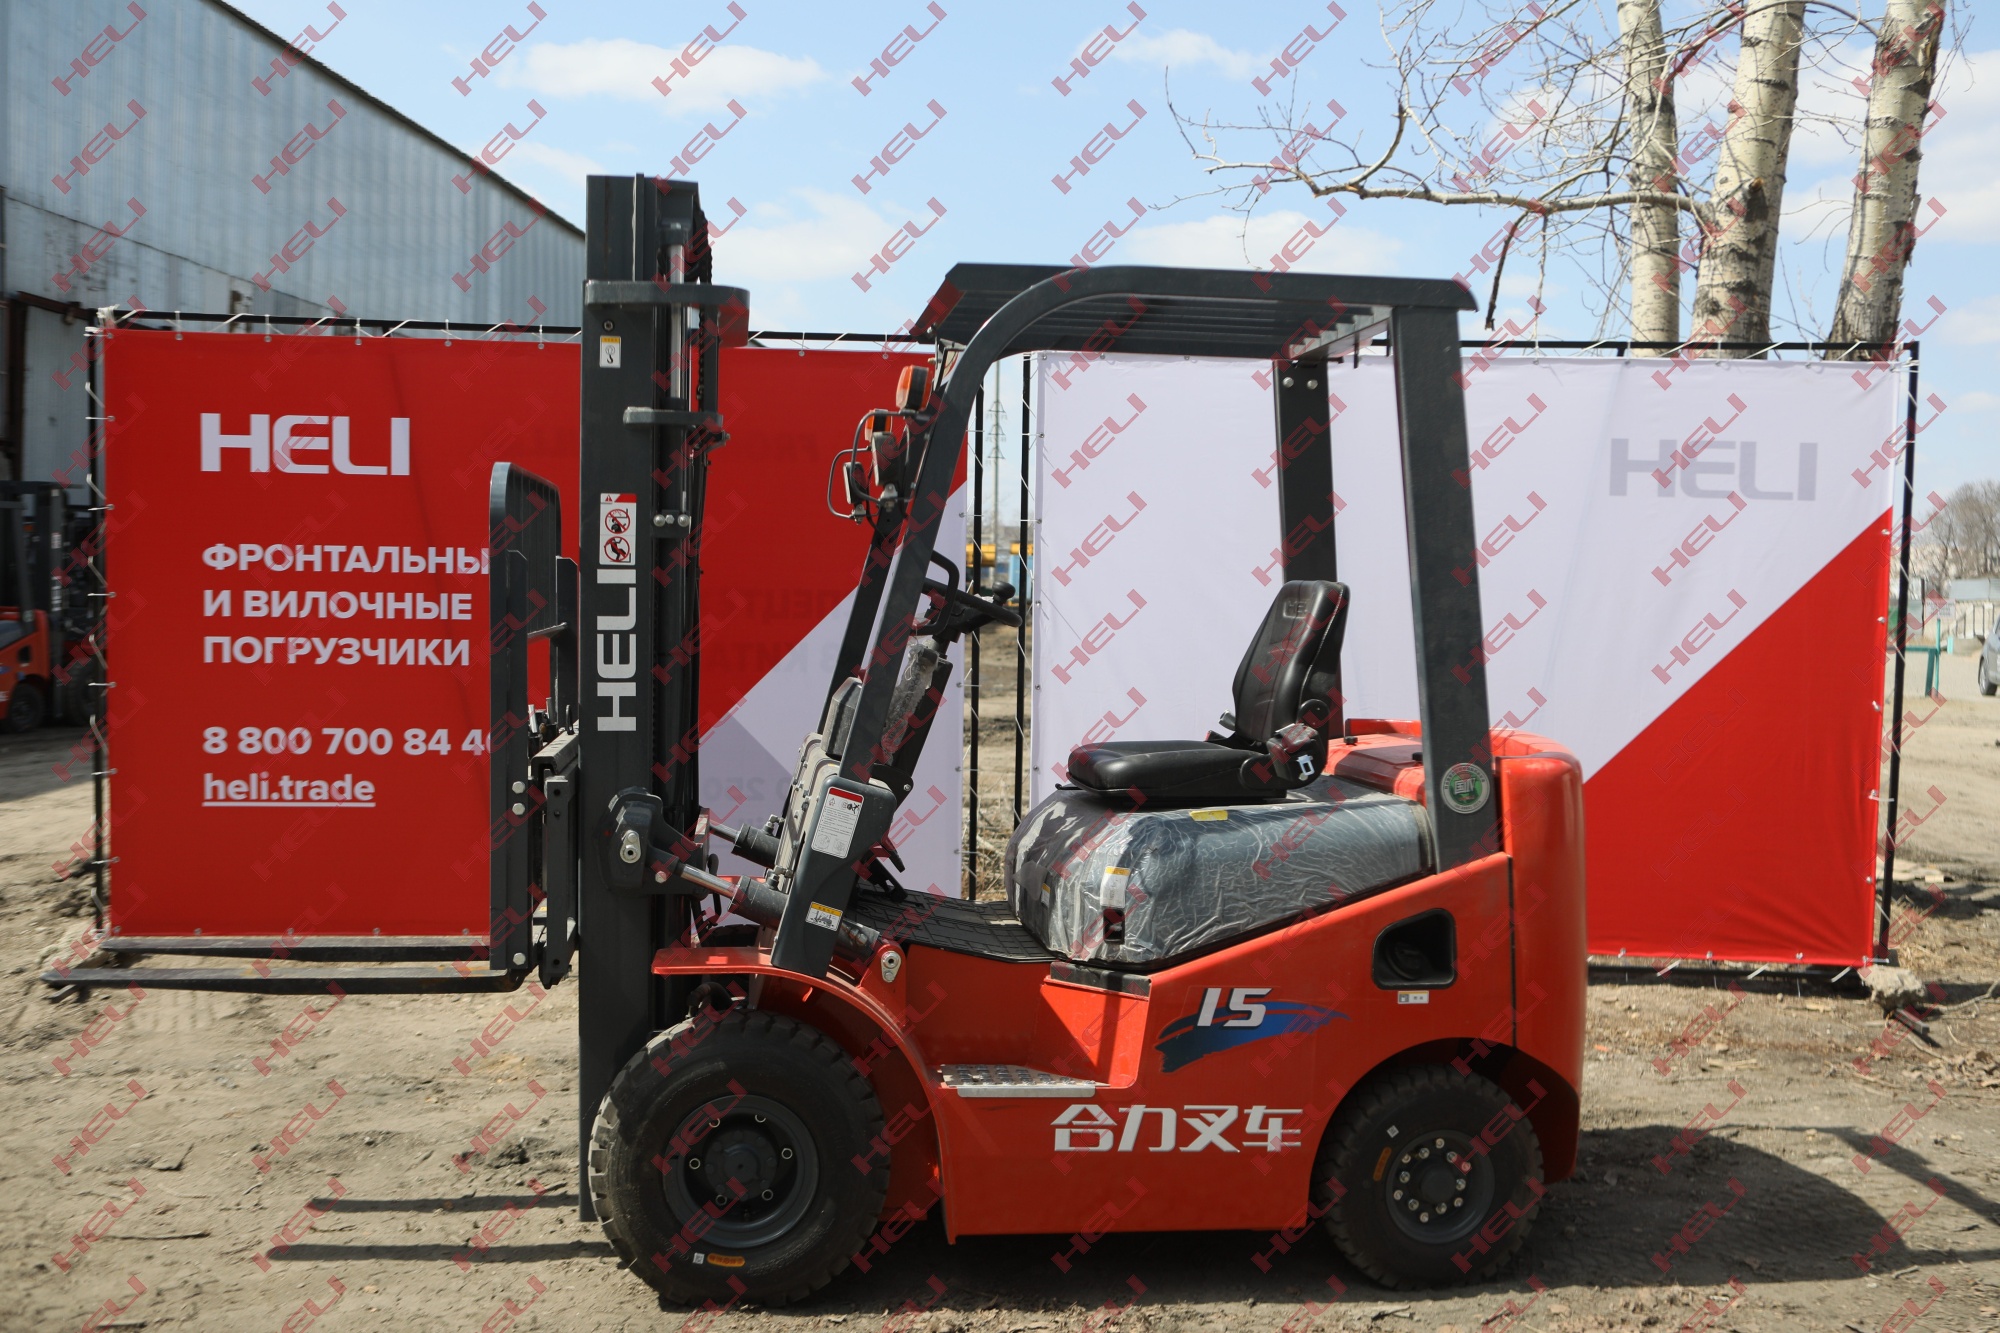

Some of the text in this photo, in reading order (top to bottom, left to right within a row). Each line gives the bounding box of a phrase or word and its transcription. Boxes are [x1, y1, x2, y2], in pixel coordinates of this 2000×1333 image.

[200, 412, 411, 476] HELI
[1608, 437, 1819, 502] HELI
[202, 543, 491, 576] ФРОНТАЛЬНЫ
[203, 589, 473, 620] И ВИЛОЧНЫЕ
[203, 635, 471, 666] ПОГРУЗЧИКИ
[596, 568, 637, 732] HELI
[202, 726, 491, 757] 8 800 700 84 4
[202, 772, 376, 801] heli.trade
[1196, 987, 1273, 1028] 15
[1050, 1103, 1304, 1153] 合力叉车
